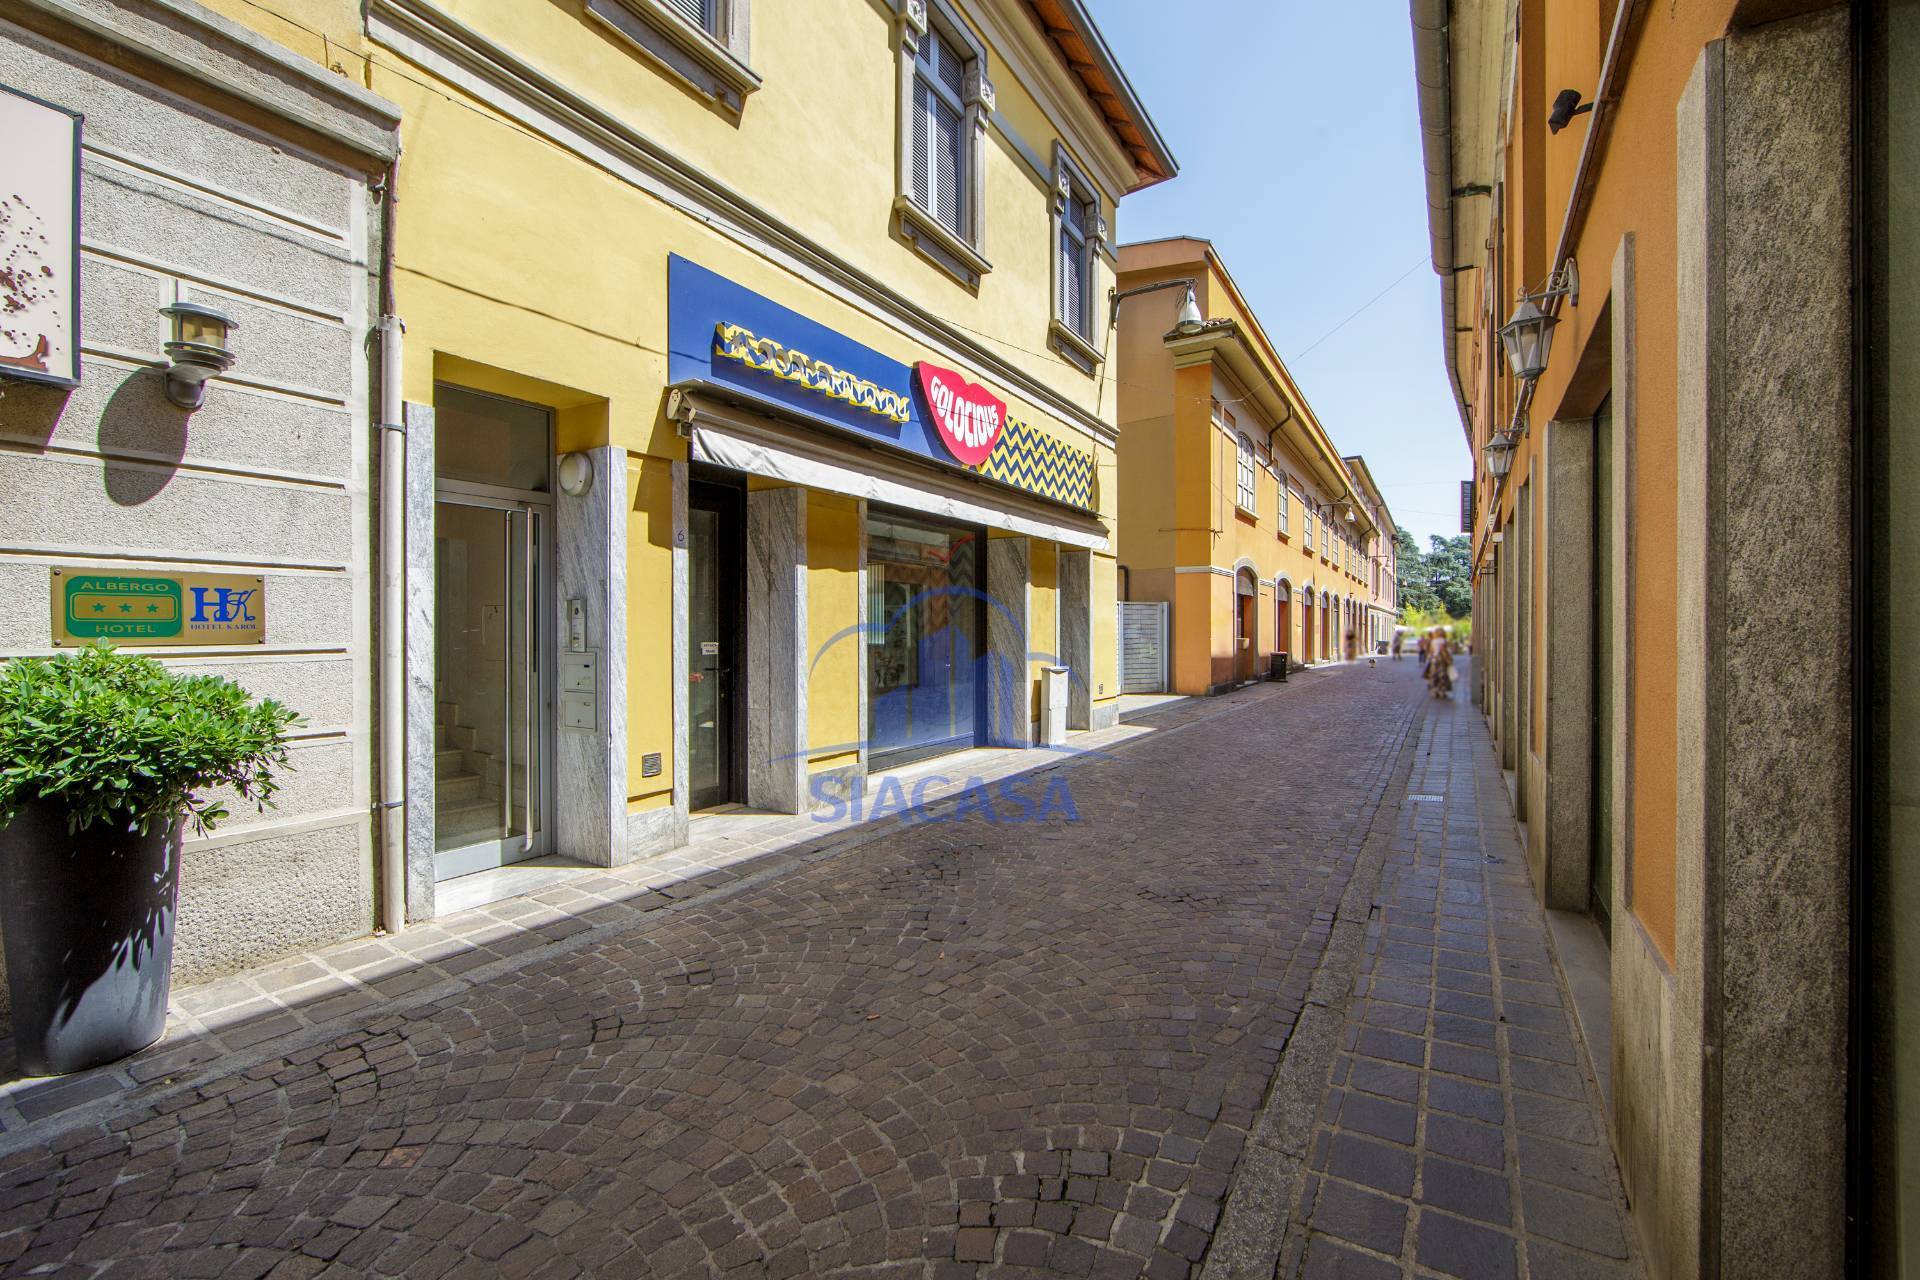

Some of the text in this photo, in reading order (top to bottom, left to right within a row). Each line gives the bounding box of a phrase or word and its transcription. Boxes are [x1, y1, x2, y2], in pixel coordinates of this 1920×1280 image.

[930, 375, 999, 448] GOLOCIOUS
[677, 529, 685, 542] 6
[80, 582, 169, 592] ALBERGO
[95, 624, 157, 633] HOTEL
